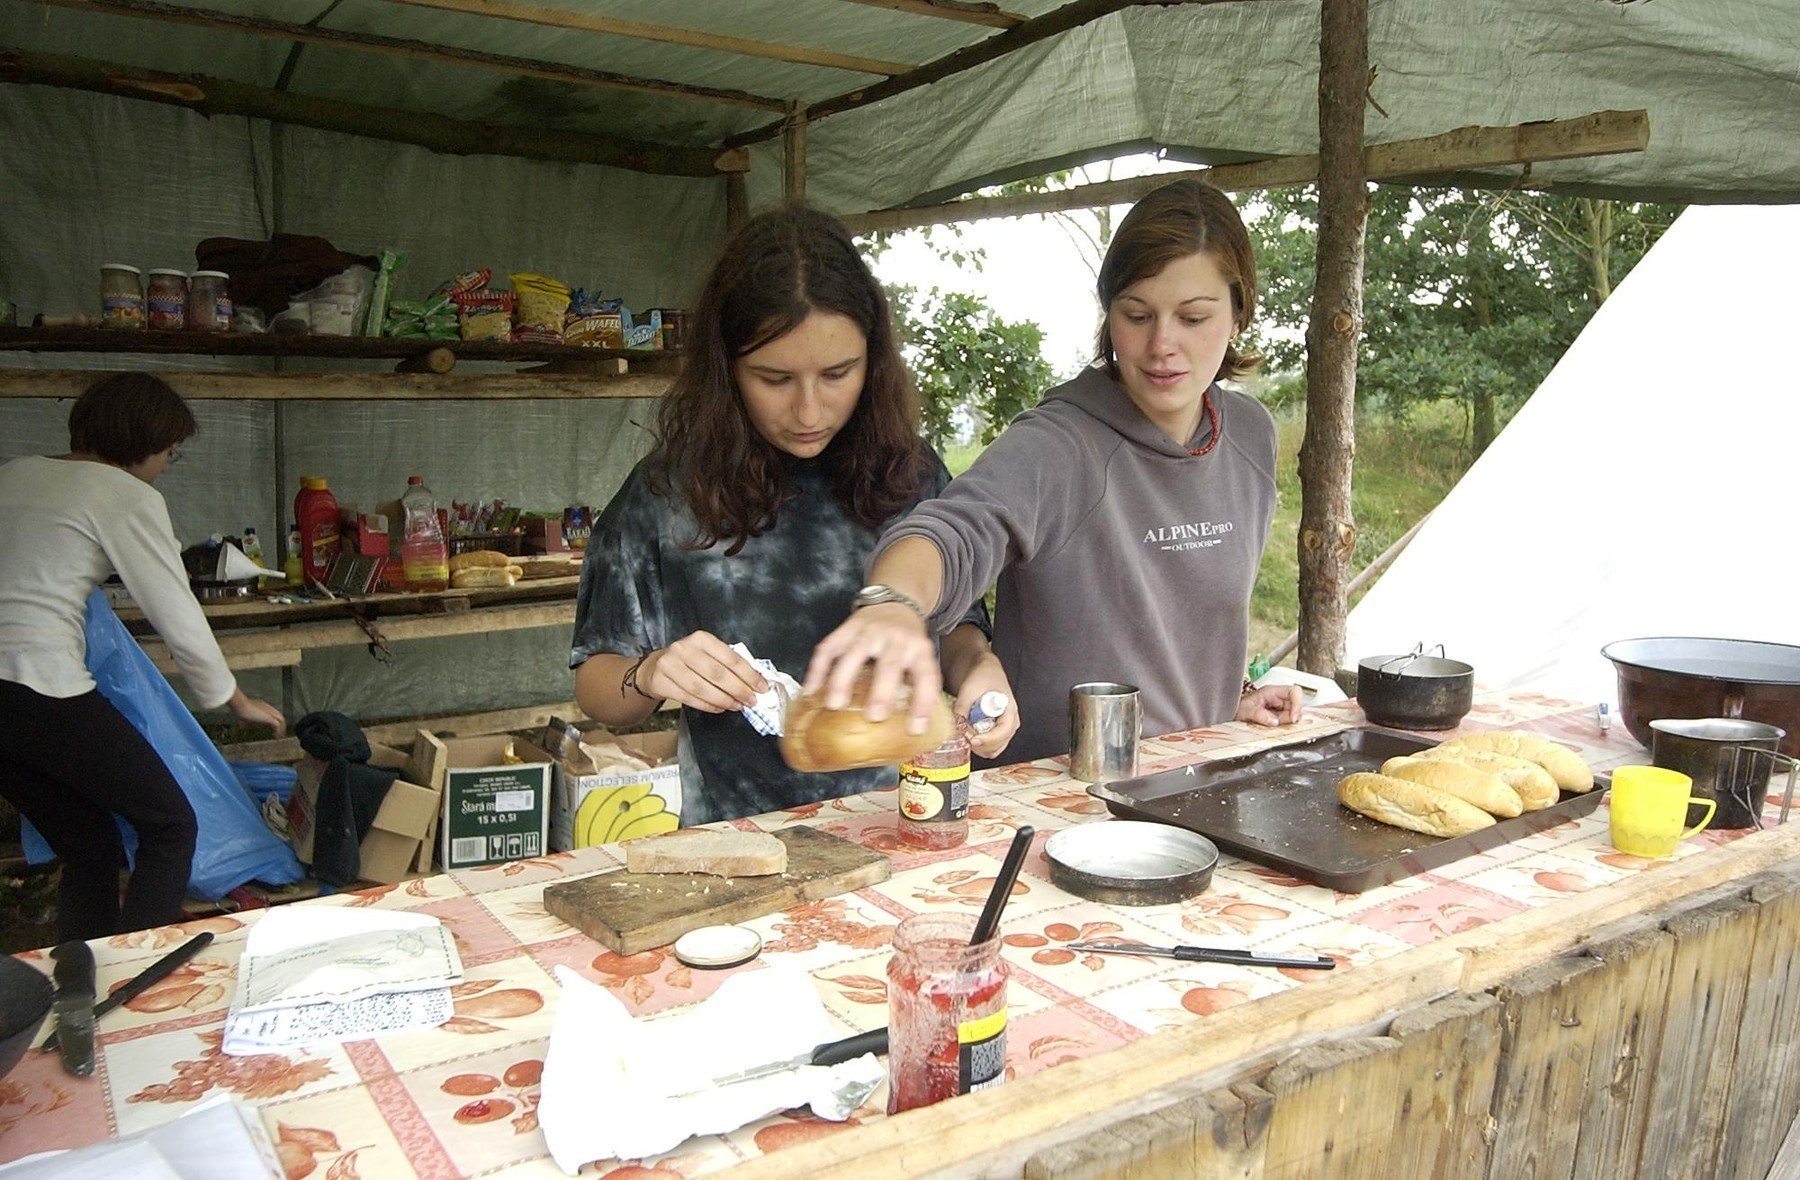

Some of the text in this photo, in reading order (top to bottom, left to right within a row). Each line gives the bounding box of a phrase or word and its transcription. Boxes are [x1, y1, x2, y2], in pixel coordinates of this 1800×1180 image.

[581, 340, 611, 349] XXL
[1171, 540, 1214, 552] OUTDOOR
[580, 774, 639, 789] SELECTION
[477, 815, 489, 825] 15
